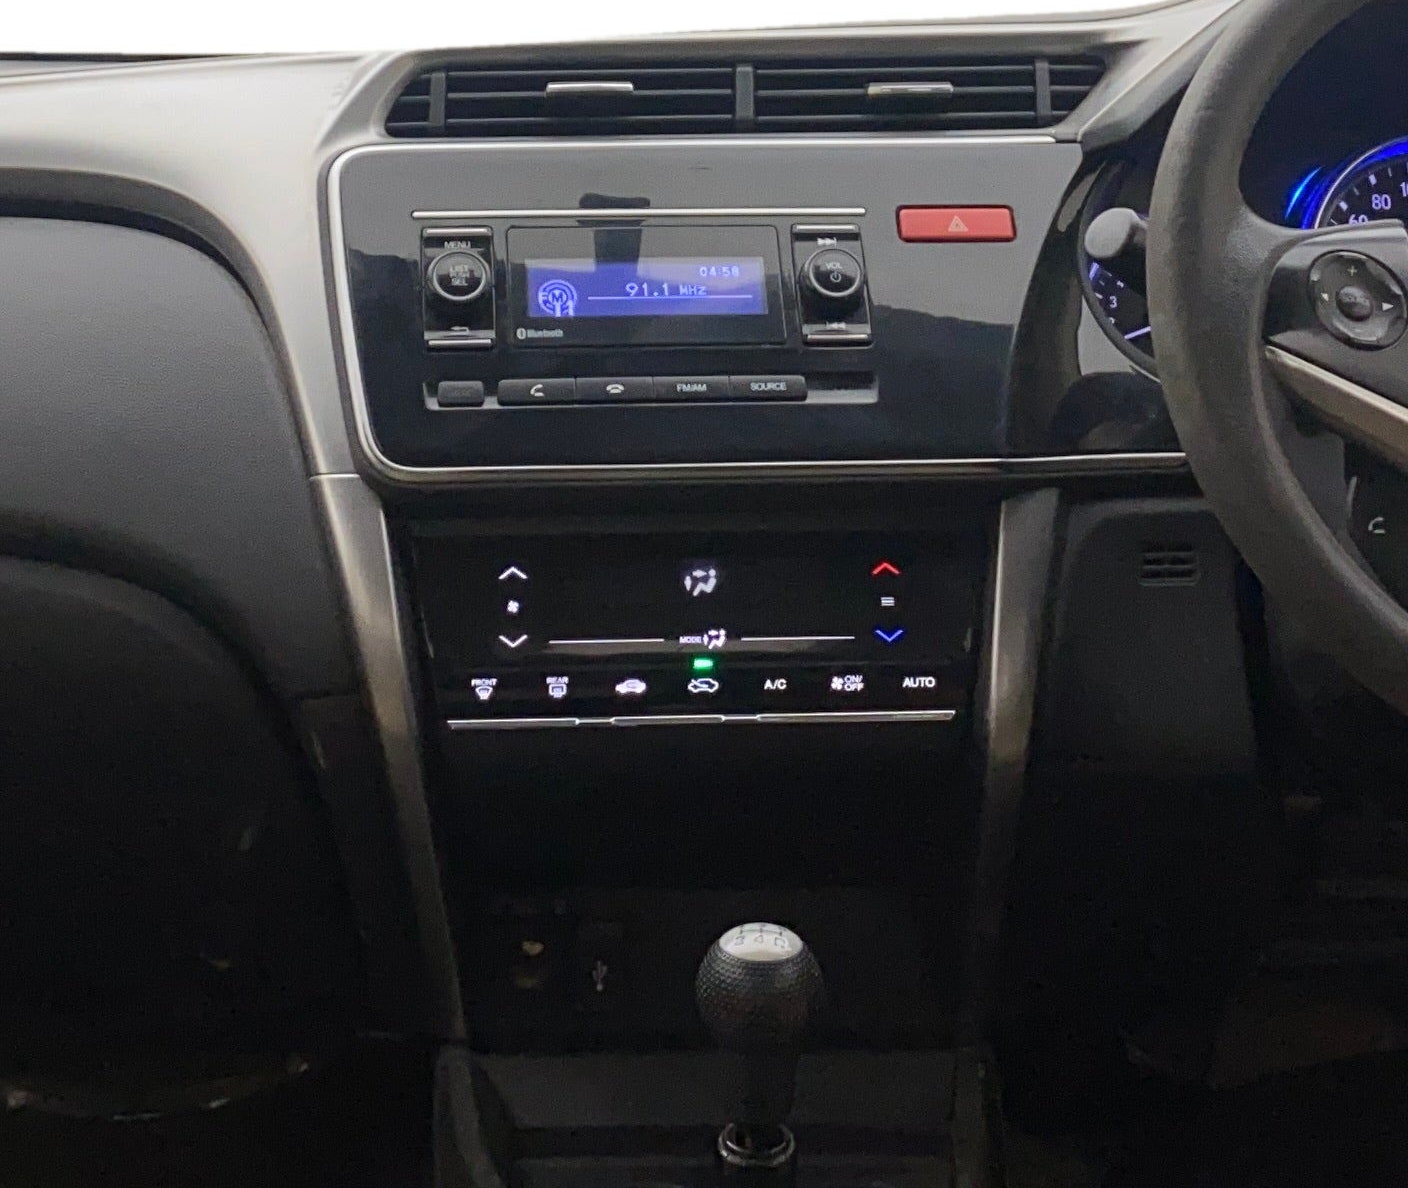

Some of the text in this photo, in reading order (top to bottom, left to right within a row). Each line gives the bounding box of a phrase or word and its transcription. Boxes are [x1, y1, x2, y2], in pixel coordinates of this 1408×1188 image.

[1372, 194, 1391, 210] 80
[444, 240, 472, 249] MENU
[625, 283, 707, 297] 91.1 MHz
[1109, 295, 1118, 308] 3
[750, 381, 787, 391] SOURCE
[679, 635, 702, 644] MODE
[471, 678, 497, 687] FRONT
[546, 676, 569, 684] REAR
[844, 674, 863, 683] ON/
[902, 676, 936, 688] AUTO
[764, 678, 787, 690] A/C
[844, 682, 864, 692] OFF
